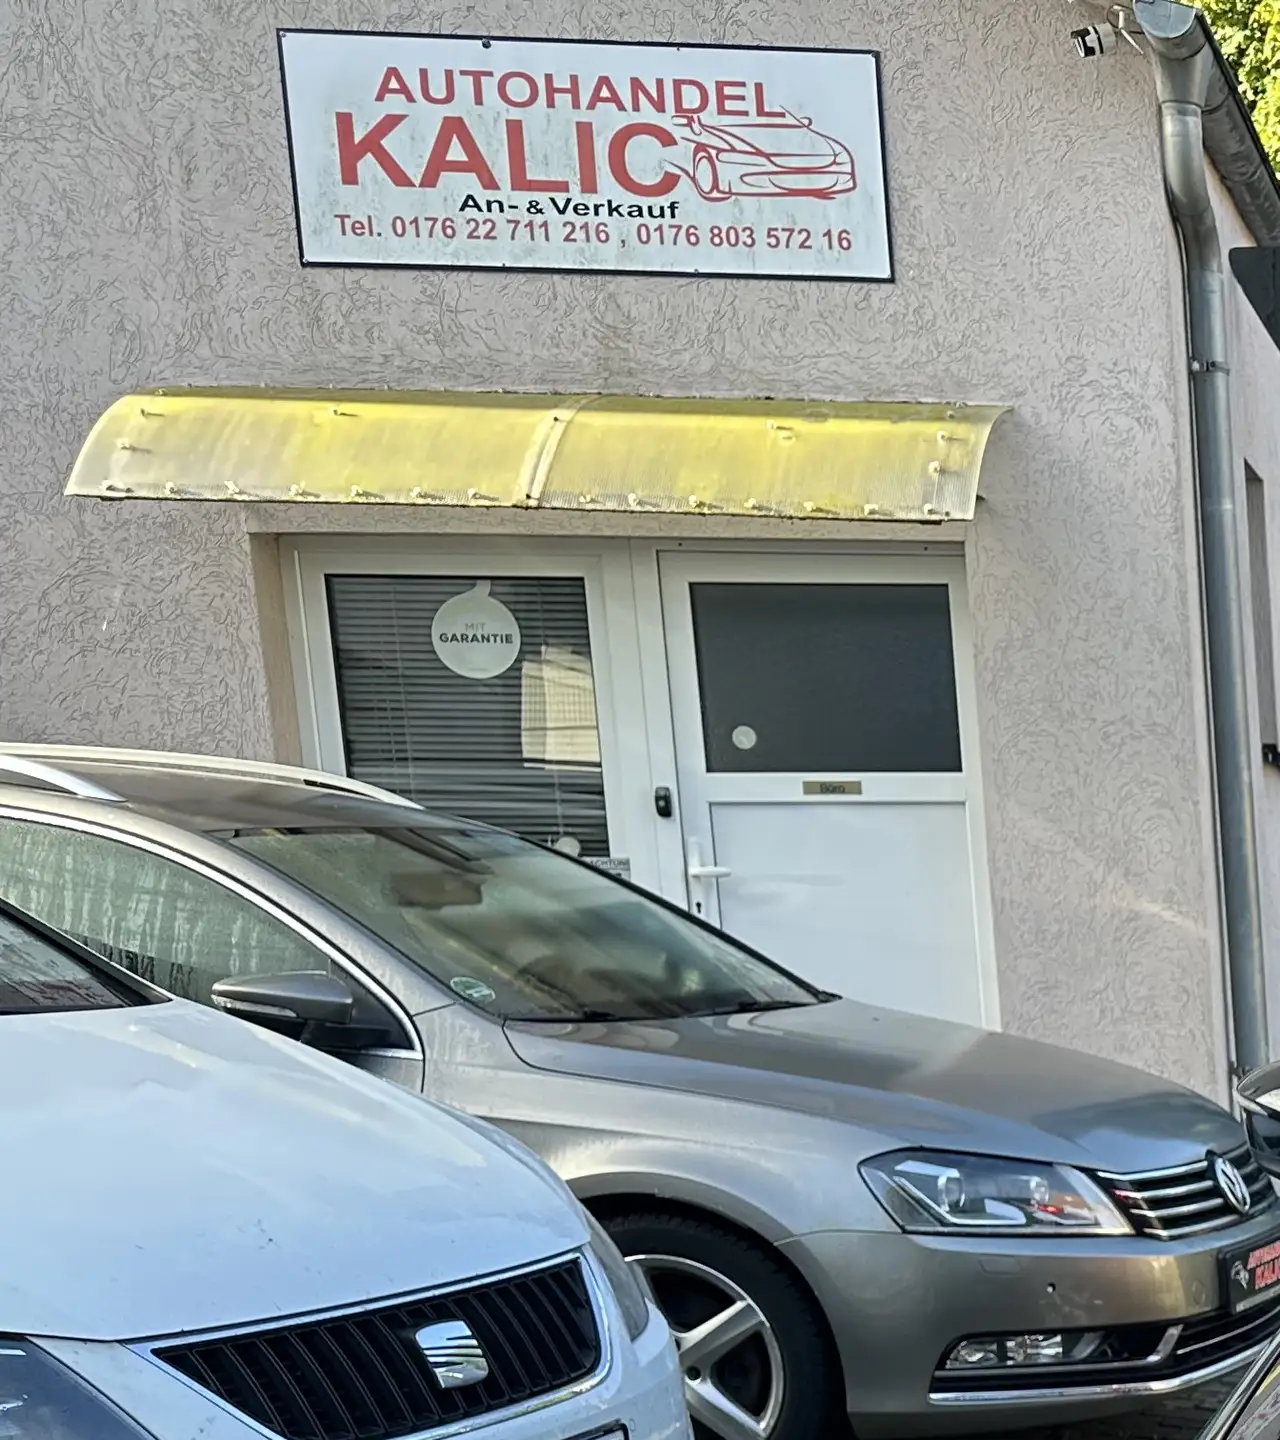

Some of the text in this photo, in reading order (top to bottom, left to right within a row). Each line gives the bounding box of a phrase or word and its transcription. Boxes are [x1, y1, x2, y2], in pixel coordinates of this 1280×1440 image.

[373, 65, 787, 118] AUTOHANDEL
[334, 111, 682, 197] KALIC
[526, 199, 544, 215] &
[548, 197, 680, 219] Verkauf
[334, 213, 382, 238] Tel.
[391, 215, 457, 240] 0176
[466, 217, 498, 241] 22
[506, 219, 550, 243] 711
[562, 220, 611, 244] 216
[636, 223, 701, 247] 0176
[709, 225, 756, 248] 803
[766, 227, 813, 250] 572
[822, 229, 852, 251] 16
[439, 632, 514, 645] GARANTIE
[464, 623, 486, 633] MIT
